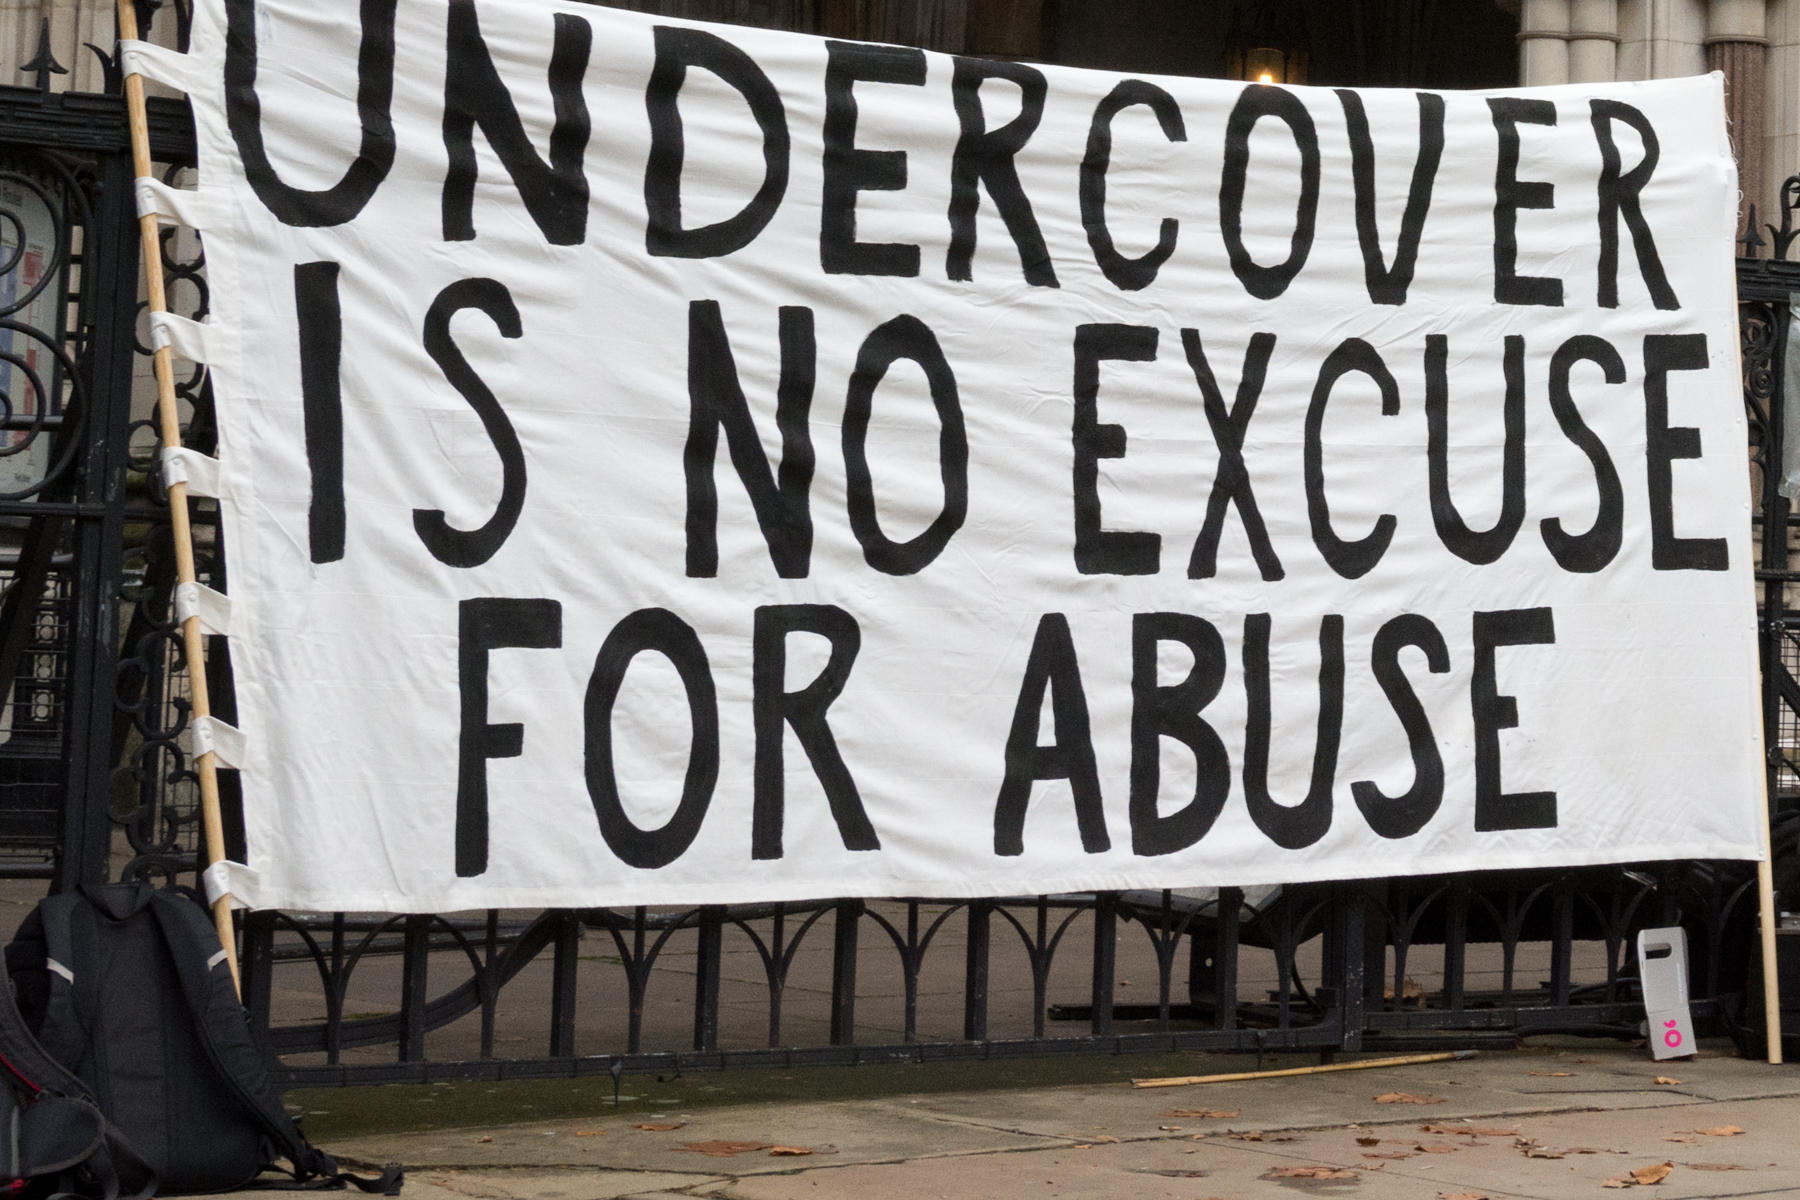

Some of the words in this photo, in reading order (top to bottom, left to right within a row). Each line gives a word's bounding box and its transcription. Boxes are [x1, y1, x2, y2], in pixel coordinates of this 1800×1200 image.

[294, 261, 527, 568] IS
[684, 299, 969, 578] NO
[1073, 323, 1729, 581] EXCUSE
[455, 598, 881, 877] FOR
[994, 606, 1558, 857] ABUSE
